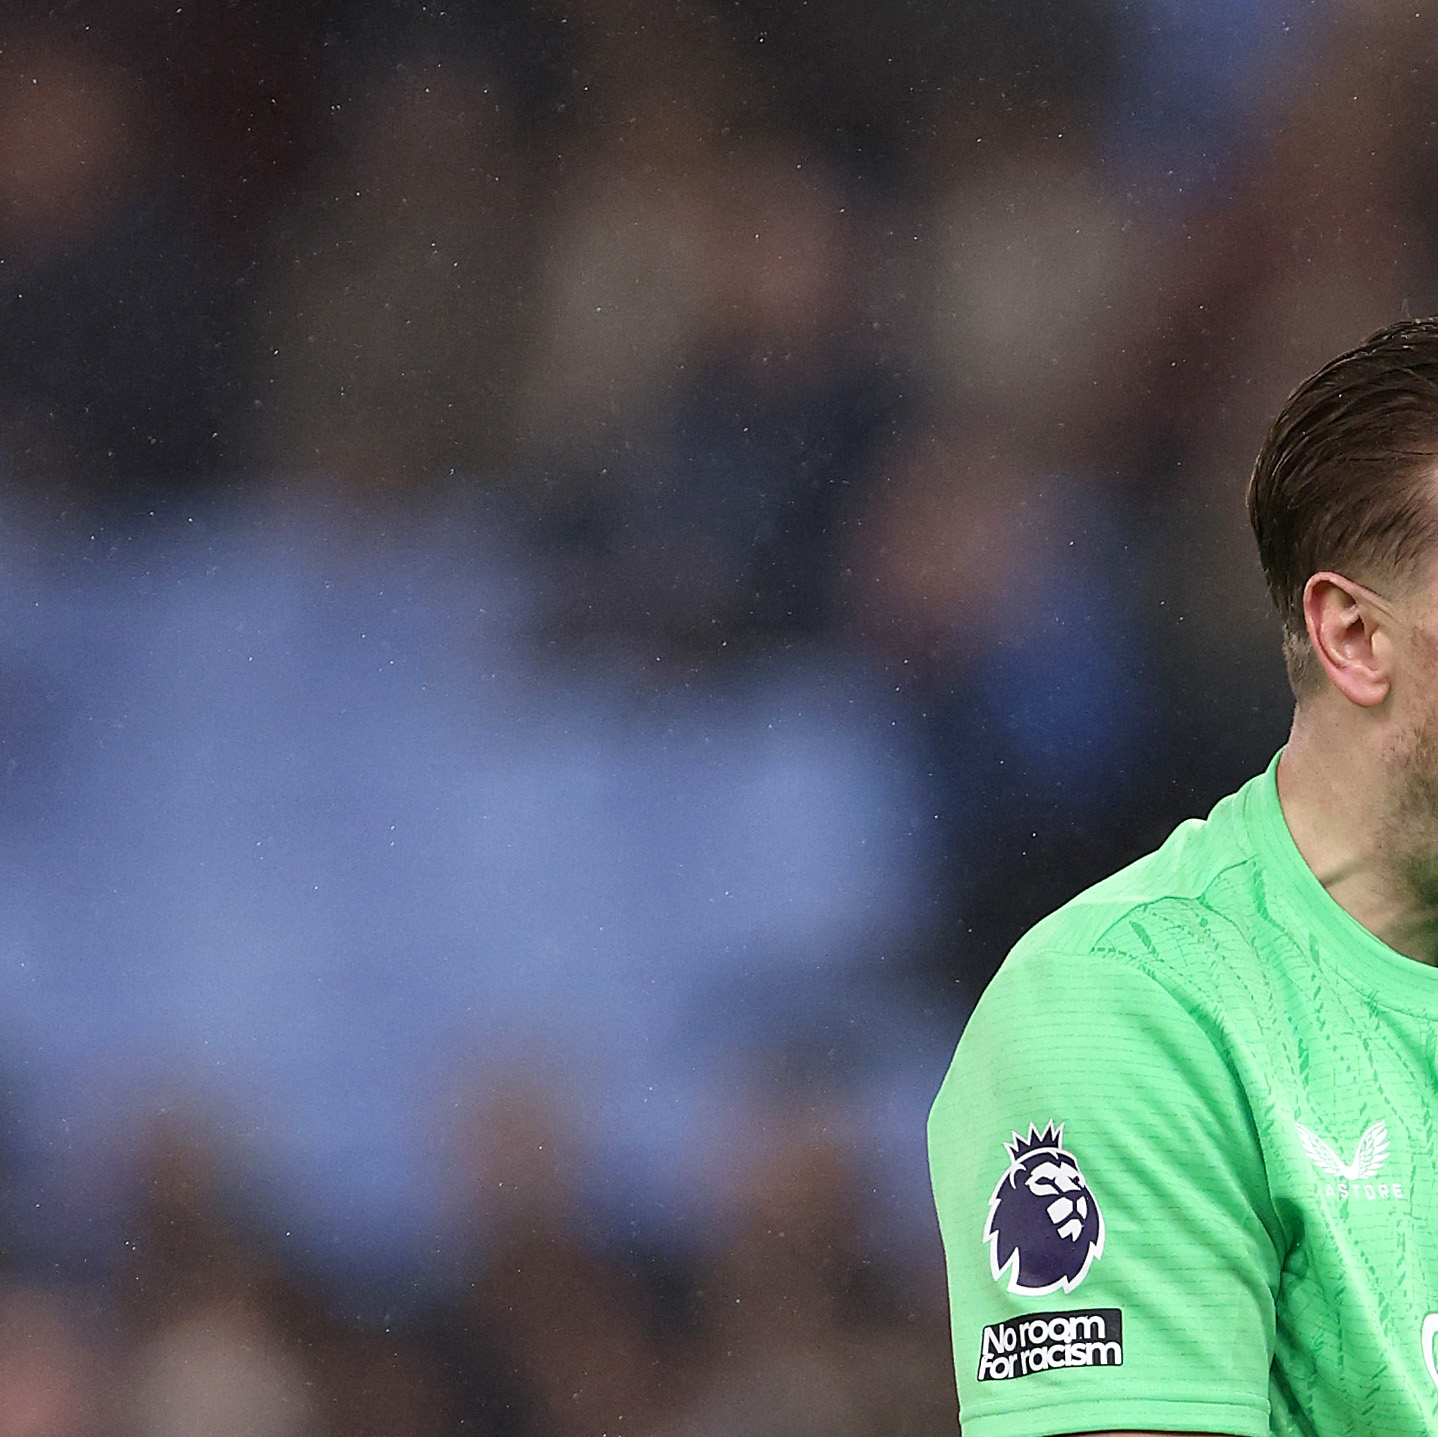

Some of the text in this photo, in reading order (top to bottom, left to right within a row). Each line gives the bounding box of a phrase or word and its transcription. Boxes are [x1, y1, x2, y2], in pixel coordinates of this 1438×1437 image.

[1324, 1183, 1404, 1200] ASTORE
[982, 1315, 1106, 1356] No room
[1021, 1341, 1122, 1375] racism
